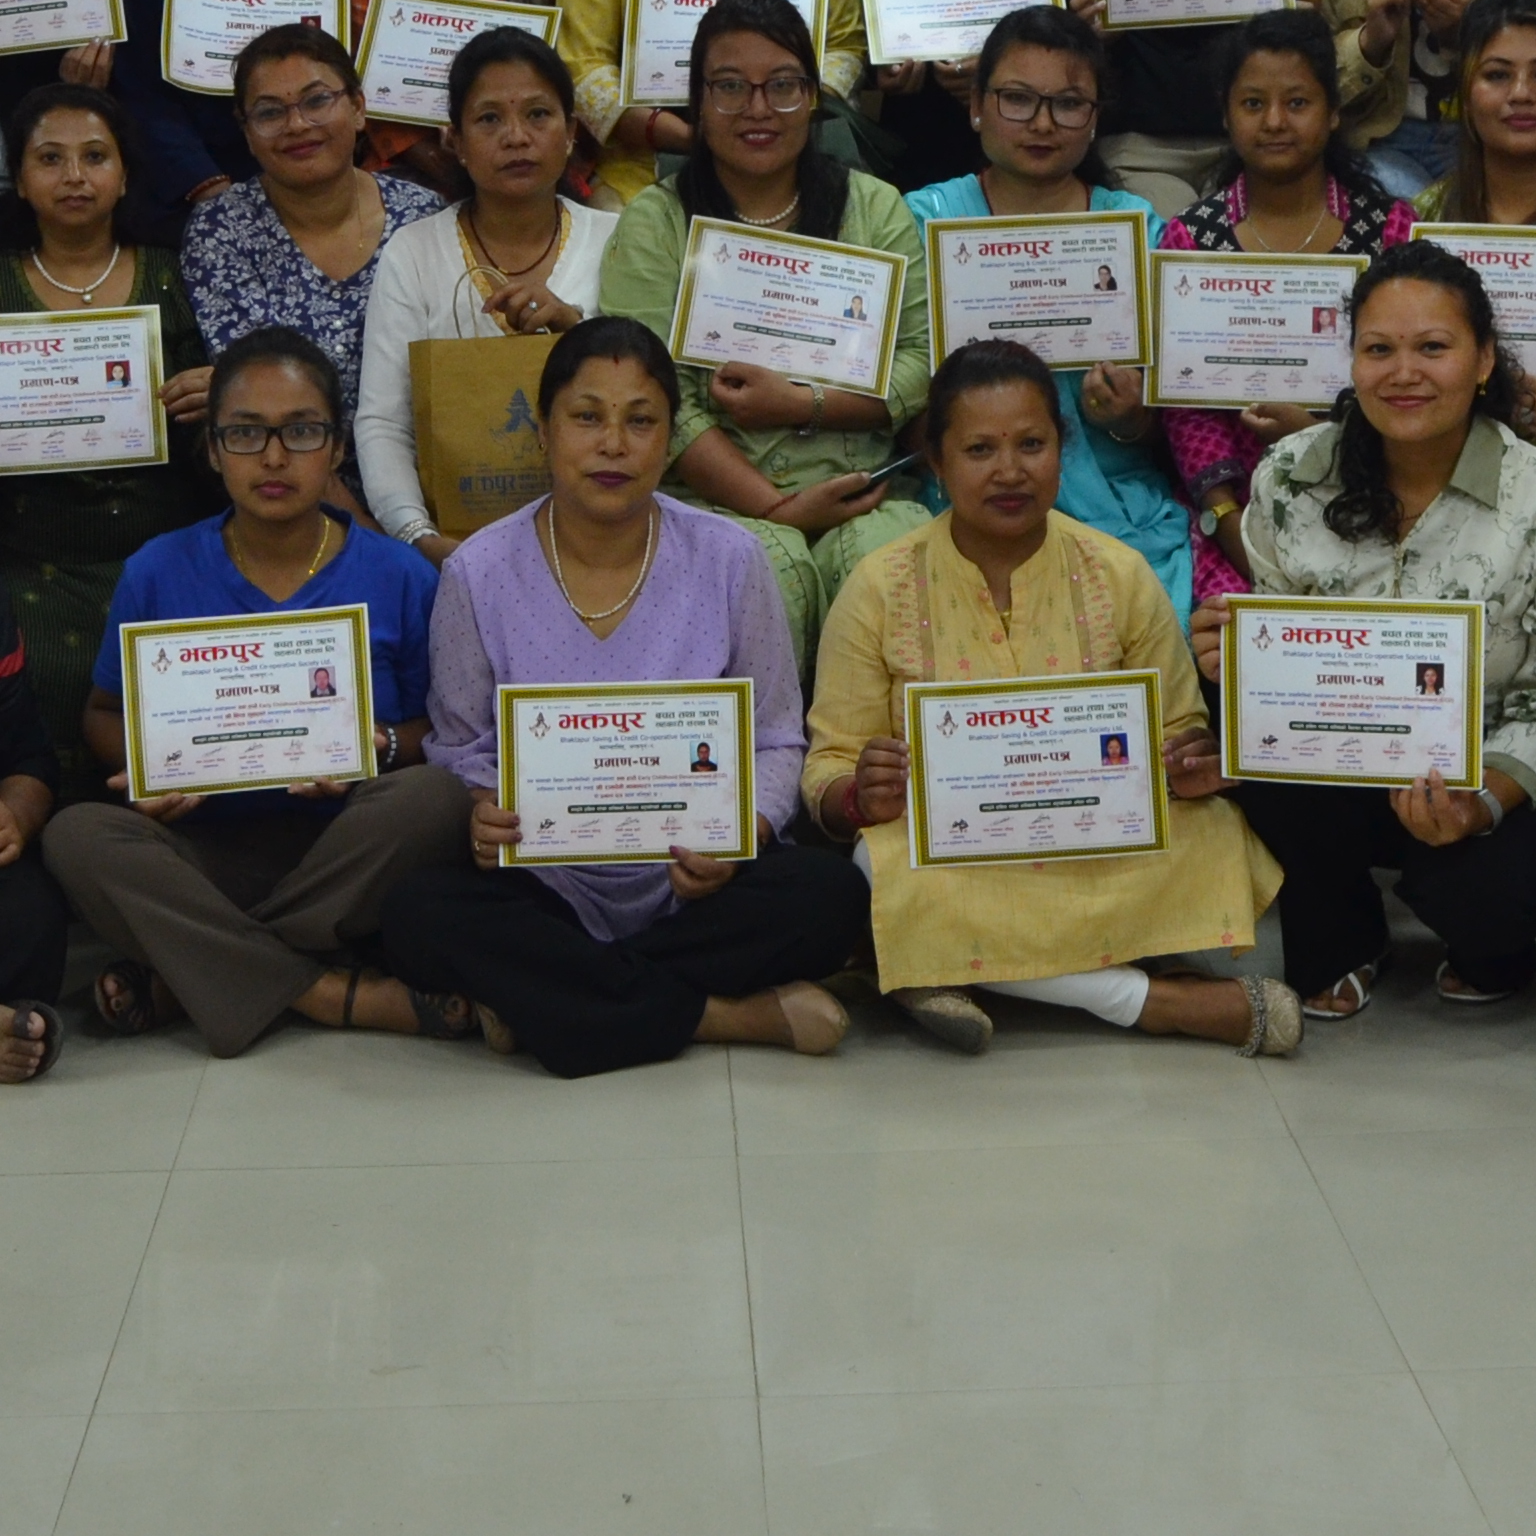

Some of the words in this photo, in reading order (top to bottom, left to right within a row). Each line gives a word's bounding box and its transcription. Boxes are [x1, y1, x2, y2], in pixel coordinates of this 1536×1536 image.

[412, 12, 479, 32] भक्तपुर
[978, 241, 1054, 258] भक्तपुर
[739, 248, 814, 274] भक्तपुर
[1200, 278, 1276, 296] भक्तपुर
[1282, 627, 1372, 649] भक्तपुर
[180, 642, 265, 663] भक्तपुर
[559, 712, 646, 732] भक्तपुर
[966, 707, 1054, 728] भक्तपुर
